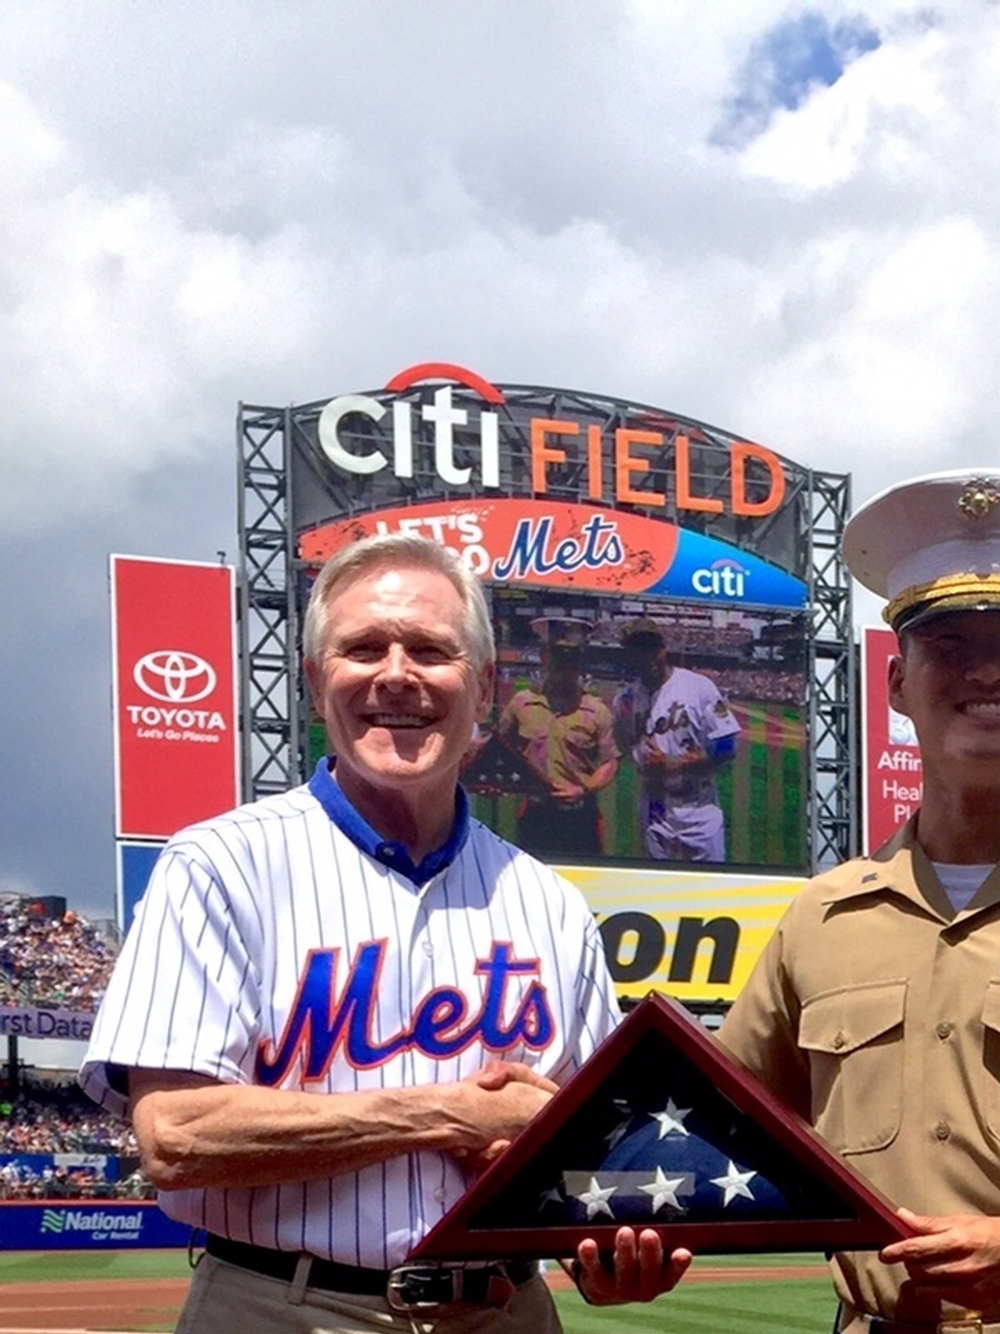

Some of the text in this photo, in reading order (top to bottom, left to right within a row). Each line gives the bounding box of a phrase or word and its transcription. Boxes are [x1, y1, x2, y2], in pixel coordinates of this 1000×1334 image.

[318, 386, 786, 517] citi FIELD
[491, 513, 626, 582] Mets
[692, 568, 743, 597] citi
[126, 705, 226, 731] TOYOTA
[164, 729, 182, 740] Go
[37, 1011, 92, 1038] Data
[254, 937, 556, 1087] Mets
[65, 1211, 142, 1230] National
